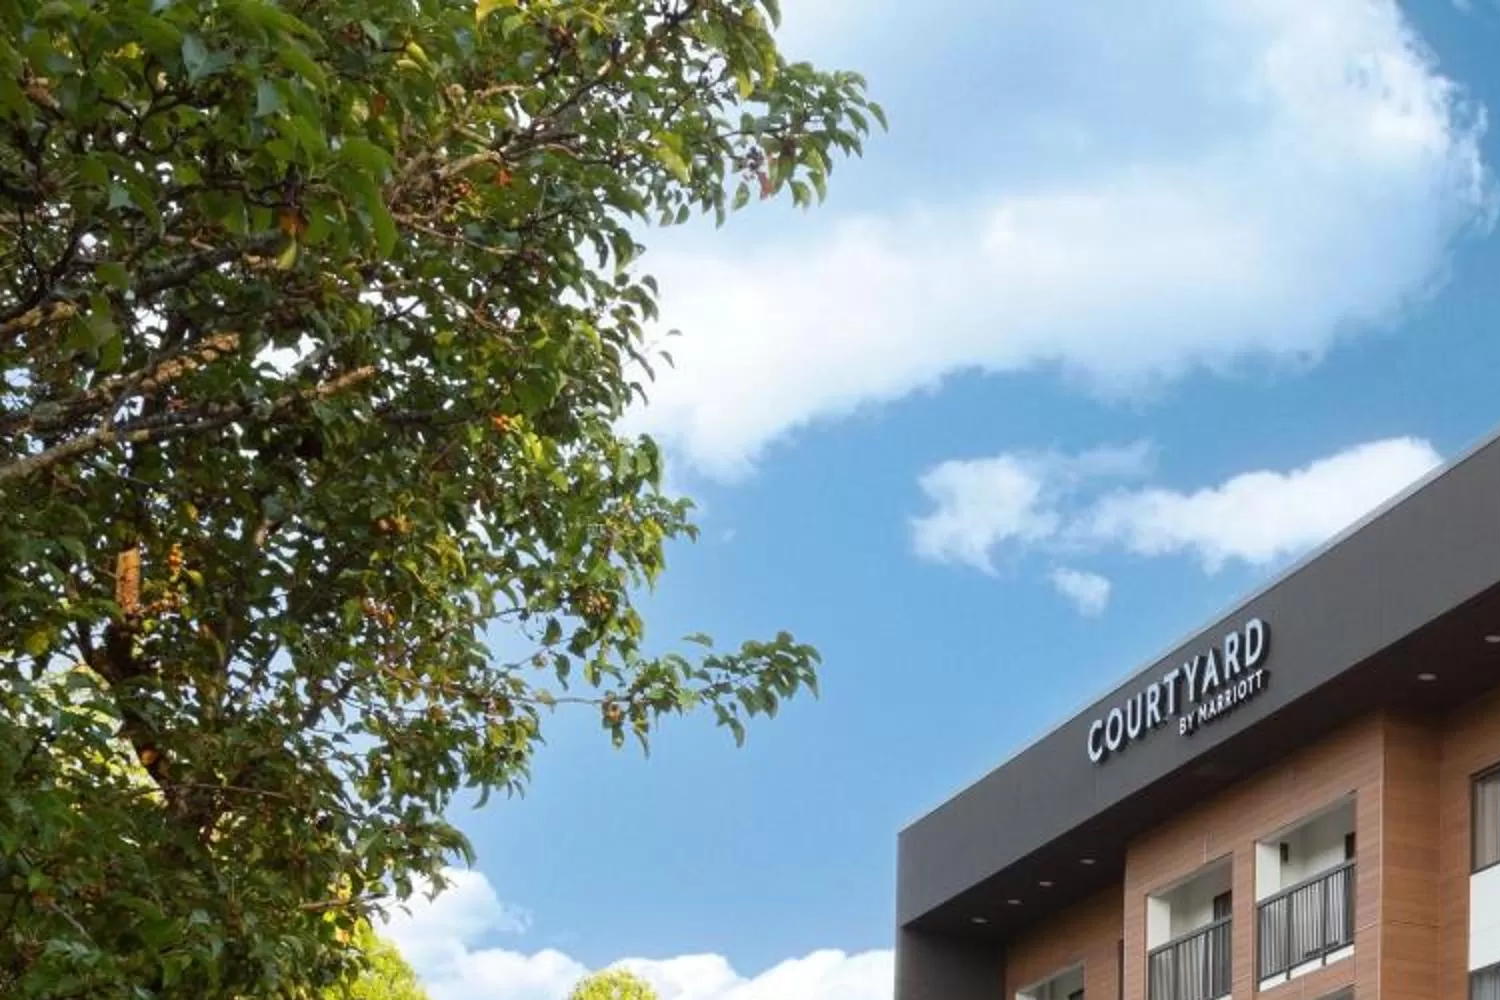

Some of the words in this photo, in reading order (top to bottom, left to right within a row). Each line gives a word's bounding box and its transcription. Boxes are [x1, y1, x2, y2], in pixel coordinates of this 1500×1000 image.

[1087, 617, 1264, 763] COURTYARD
[1179, 709, 1195, 736] BY
[1197, 669, 1263, 724] MARRIOTT
